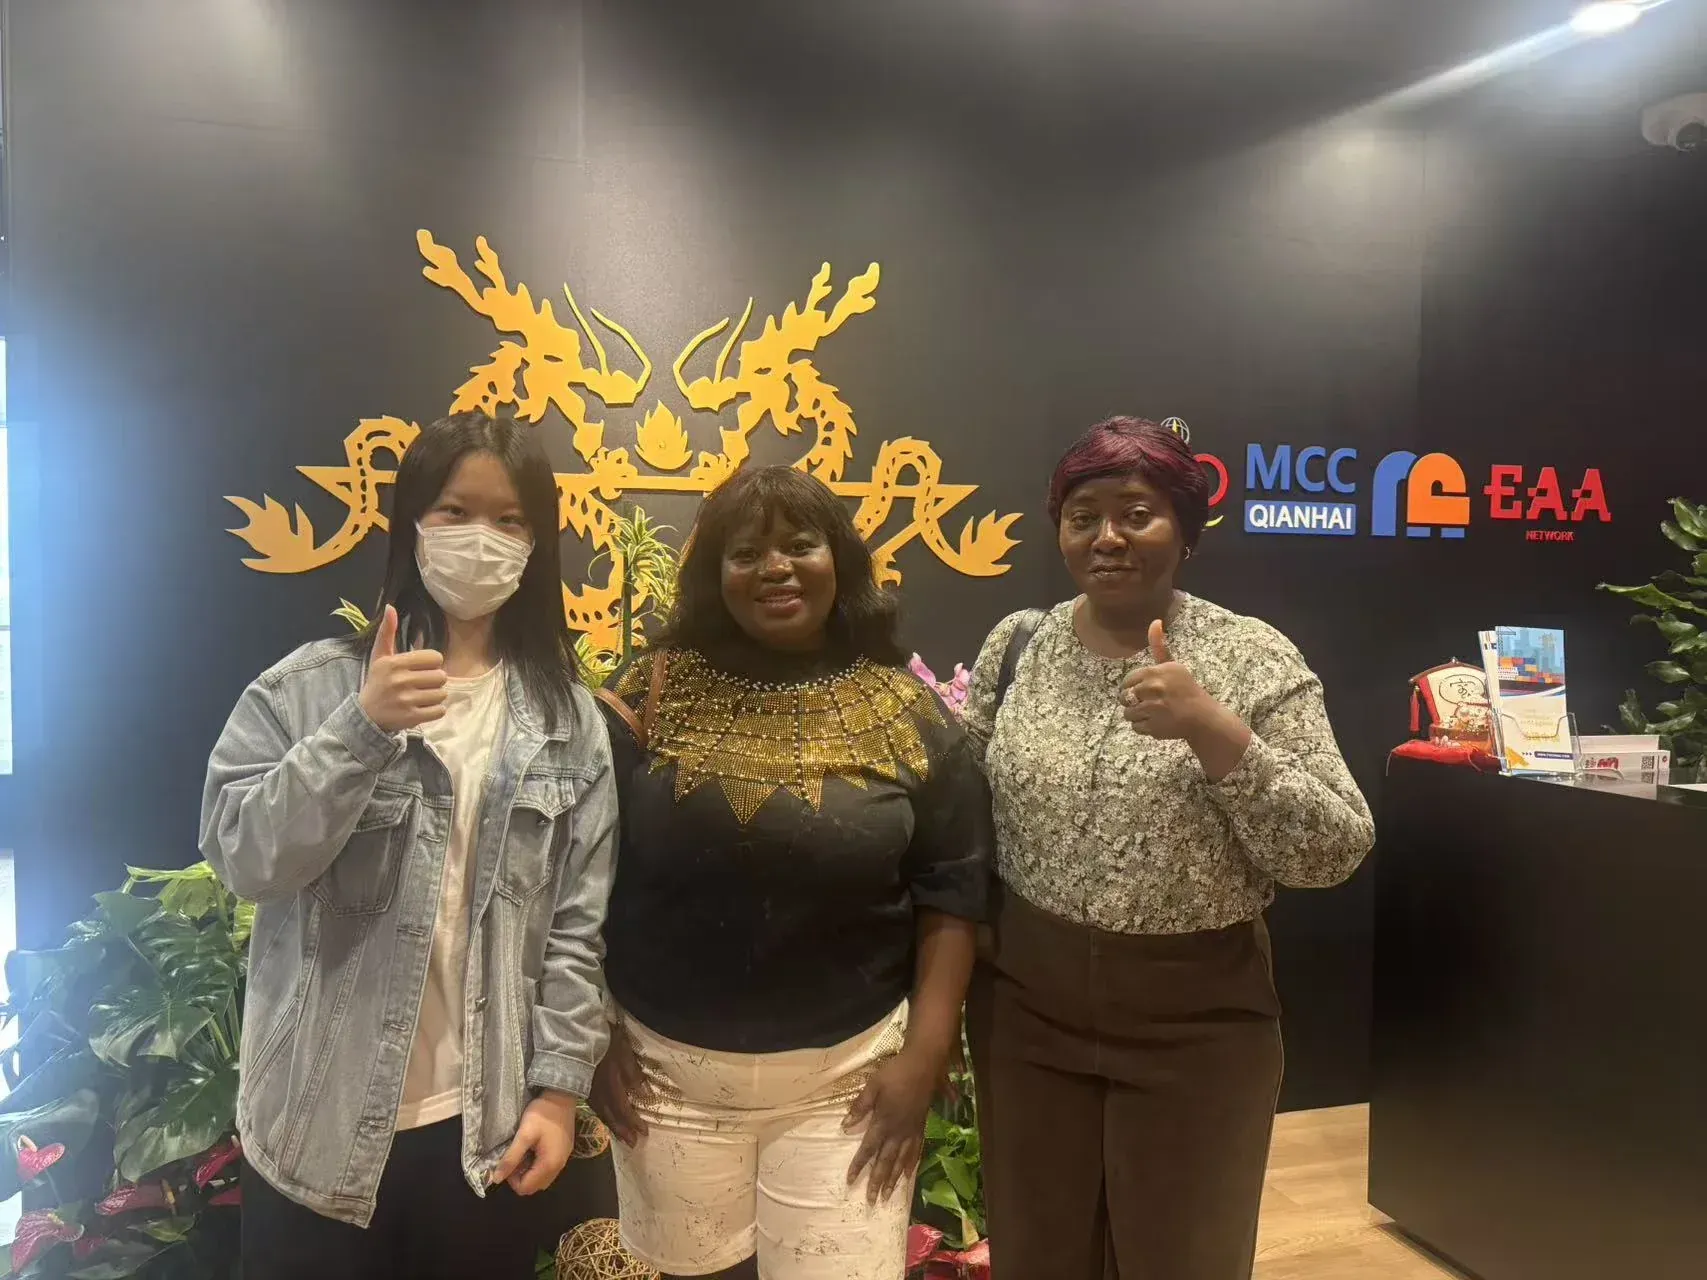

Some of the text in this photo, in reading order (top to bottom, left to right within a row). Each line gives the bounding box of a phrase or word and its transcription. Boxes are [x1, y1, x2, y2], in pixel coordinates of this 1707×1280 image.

[1246, 443, 1357, 493] MCC
[1484, 464, 1611, 522] EAA
[1249, 504, 1352, 529] QIANHAI
[1526, 530, 1575, 541] NETWORK
